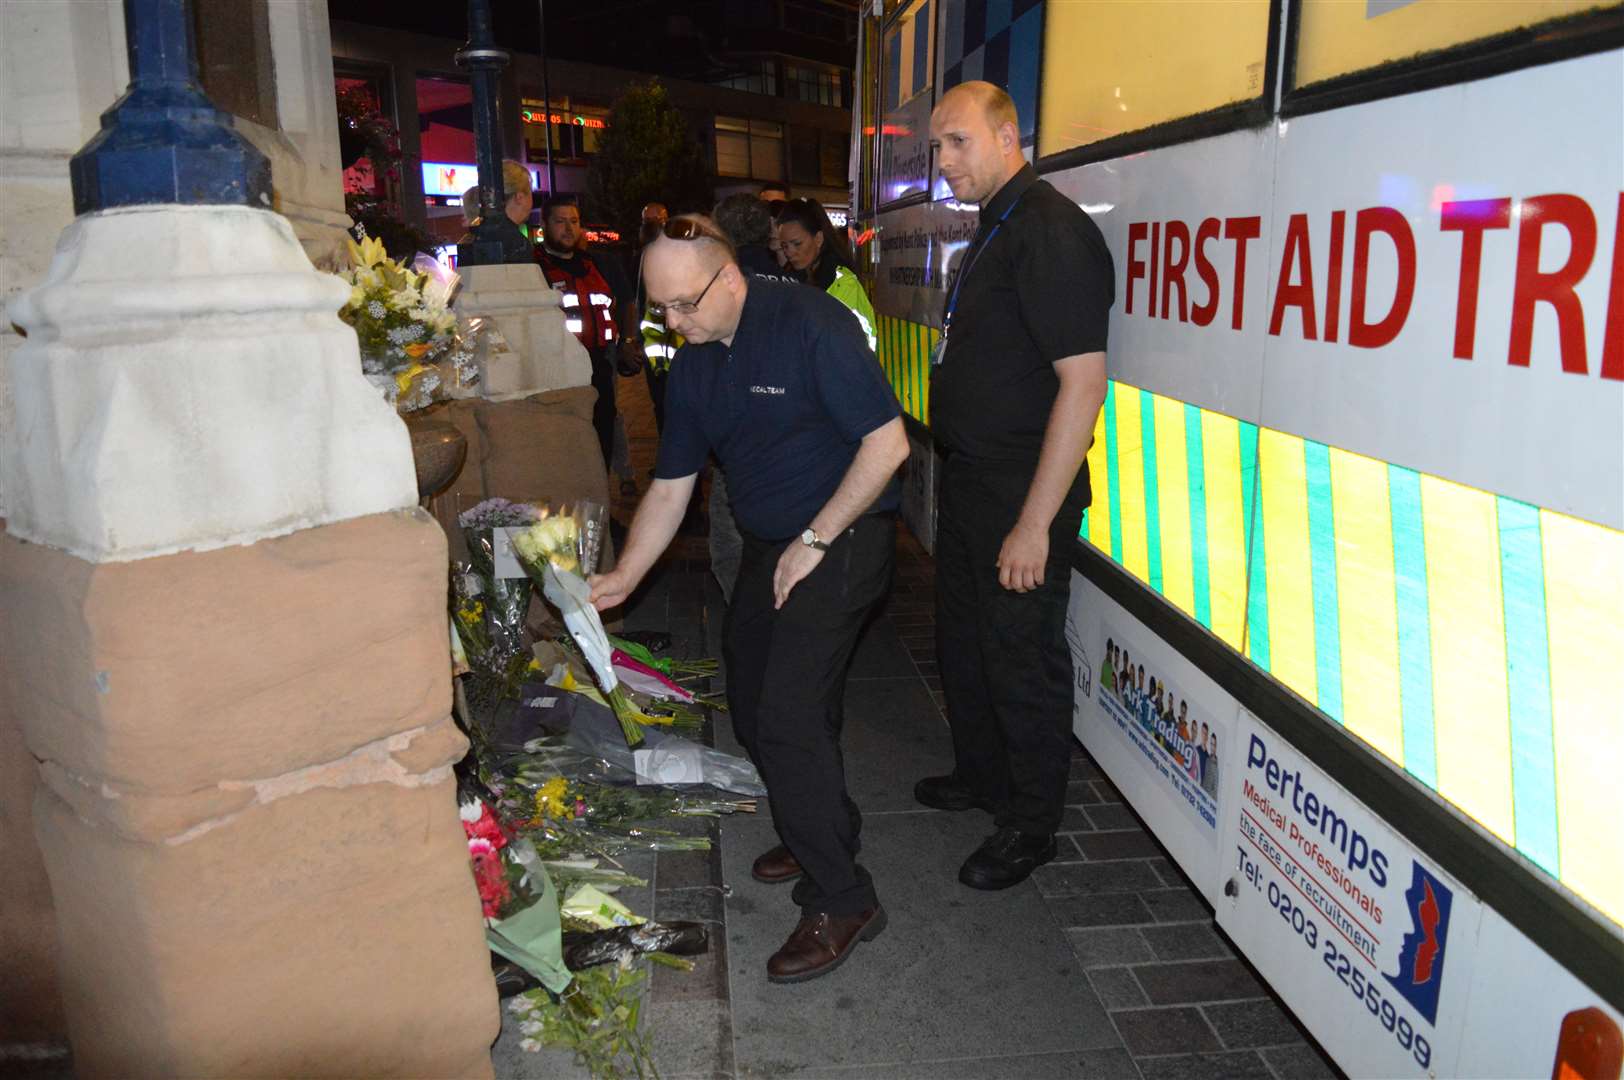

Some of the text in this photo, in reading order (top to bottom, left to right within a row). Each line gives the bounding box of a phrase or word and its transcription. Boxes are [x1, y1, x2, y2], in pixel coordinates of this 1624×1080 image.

[1125, 216, 1261, 331] FIRST
[1268, 206, 1417, 349] AID
[1077, 666, 1092, 699] Ltd
[1122, 681, 1143, 714] Ark
[1146, 697, 1193, 770] Trading
[1243, 778, 1383, 926] Medical Professionals
[1247, 732, 1389, 889] Pertemps
[1236, 844, 1433, 1070] Tel: 0203 2255999
[1239, 812, 1377, 961] the face of recruitment
